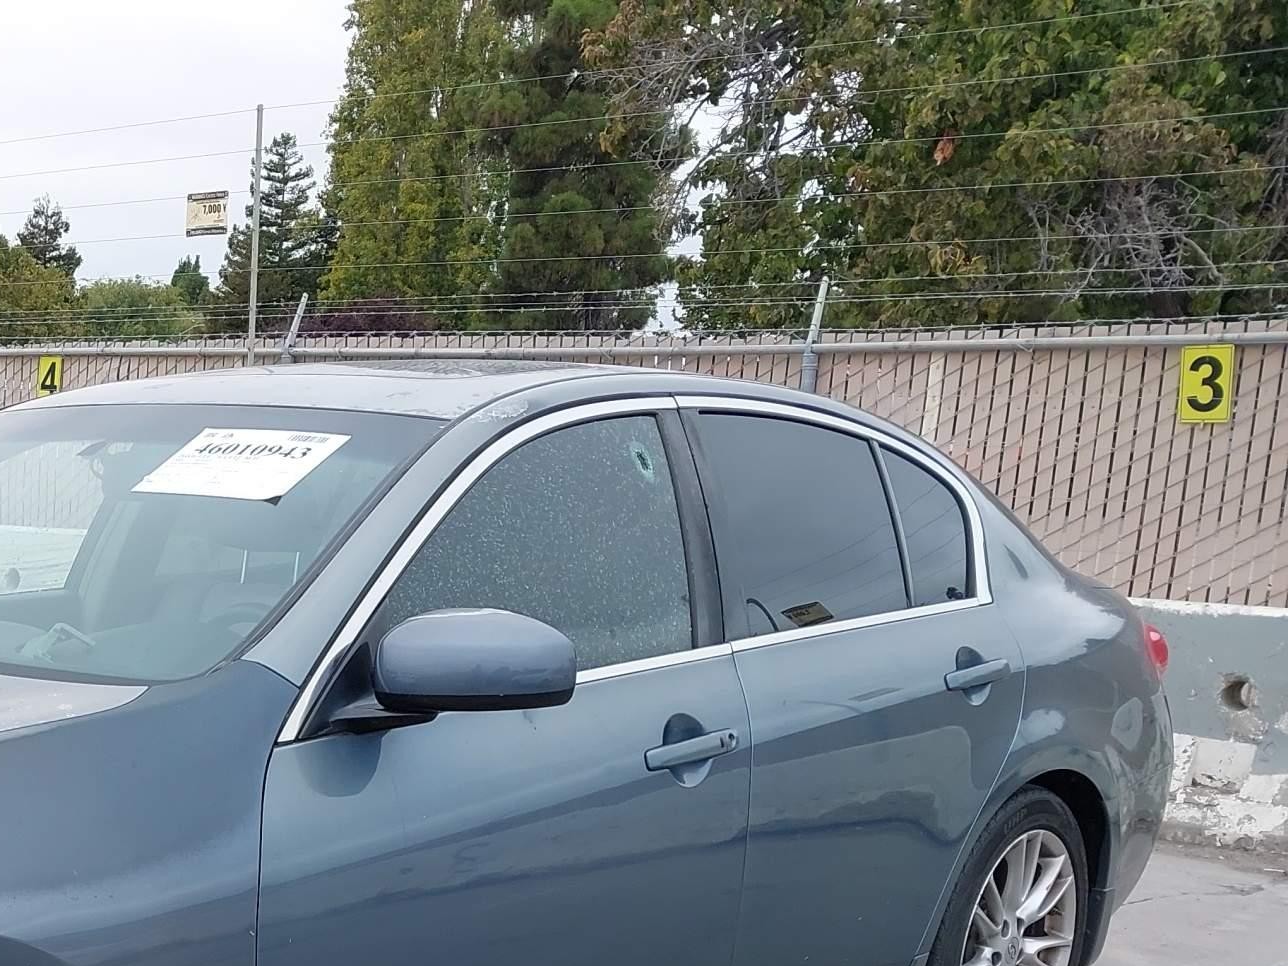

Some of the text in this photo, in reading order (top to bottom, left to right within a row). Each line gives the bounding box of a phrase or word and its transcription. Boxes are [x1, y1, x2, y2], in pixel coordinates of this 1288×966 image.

[202, 203, 222, 216] 7,000
[40, 361, 57, 395] 4
[1187, 355, 1225, 413] 3
[194, 442, 312, 460] 46010943
